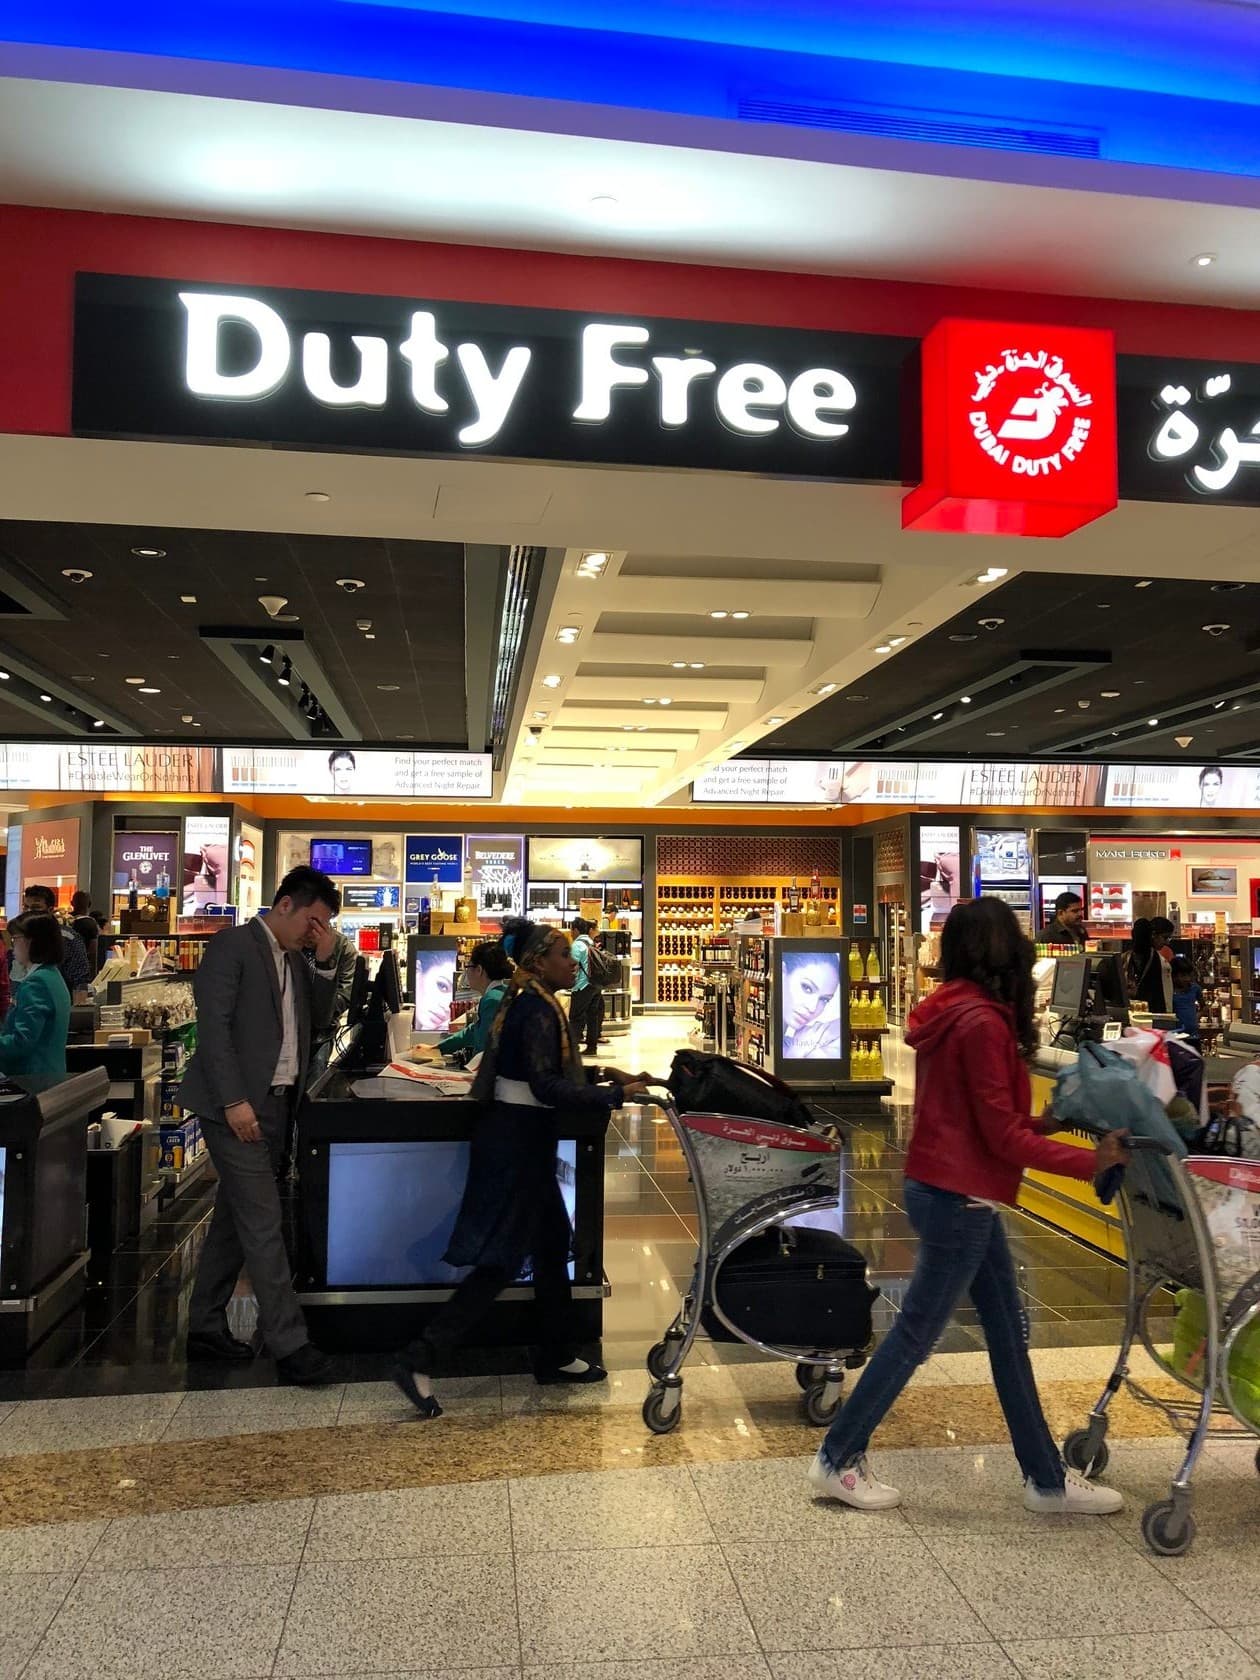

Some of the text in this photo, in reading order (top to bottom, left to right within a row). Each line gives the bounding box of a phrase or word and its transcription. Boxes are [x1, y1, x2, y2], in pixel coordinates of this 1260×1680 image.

[178, 291, 858, 447] Duty Free
[968, 411, 1091, 477] DUBAI DUTY FREE
[124, 752, 194, 768] LAUDER
[394, 757, 411, 765] Find
[412, 758, 430, 767] your
[431, 758, 457, 768] perfect
[395, 769, 409, 777] and
[430, 769, 445, 777] free
[447, 770, 473, 780] sample
[739, 765, 764, 773] perfect
[718, 777, 730, 785] get
[737, 776, 752, 784] free
[753, 776, 778, 786] sample
[1020, 770, 1082, 784] LAUDER
[395, 780, 480, 791] Advanced Night Repair
[703, 787, 738, 795] Advanced
[761, 788, 784, 797] Repair
[122, 851, 170, 862] GLENLIVET
[409, 853, 458, 861] GREY GOOSE
[475, 850, 516, 860] BELVEDERE
[1096, 849, 1166, 858] MARLBORO
